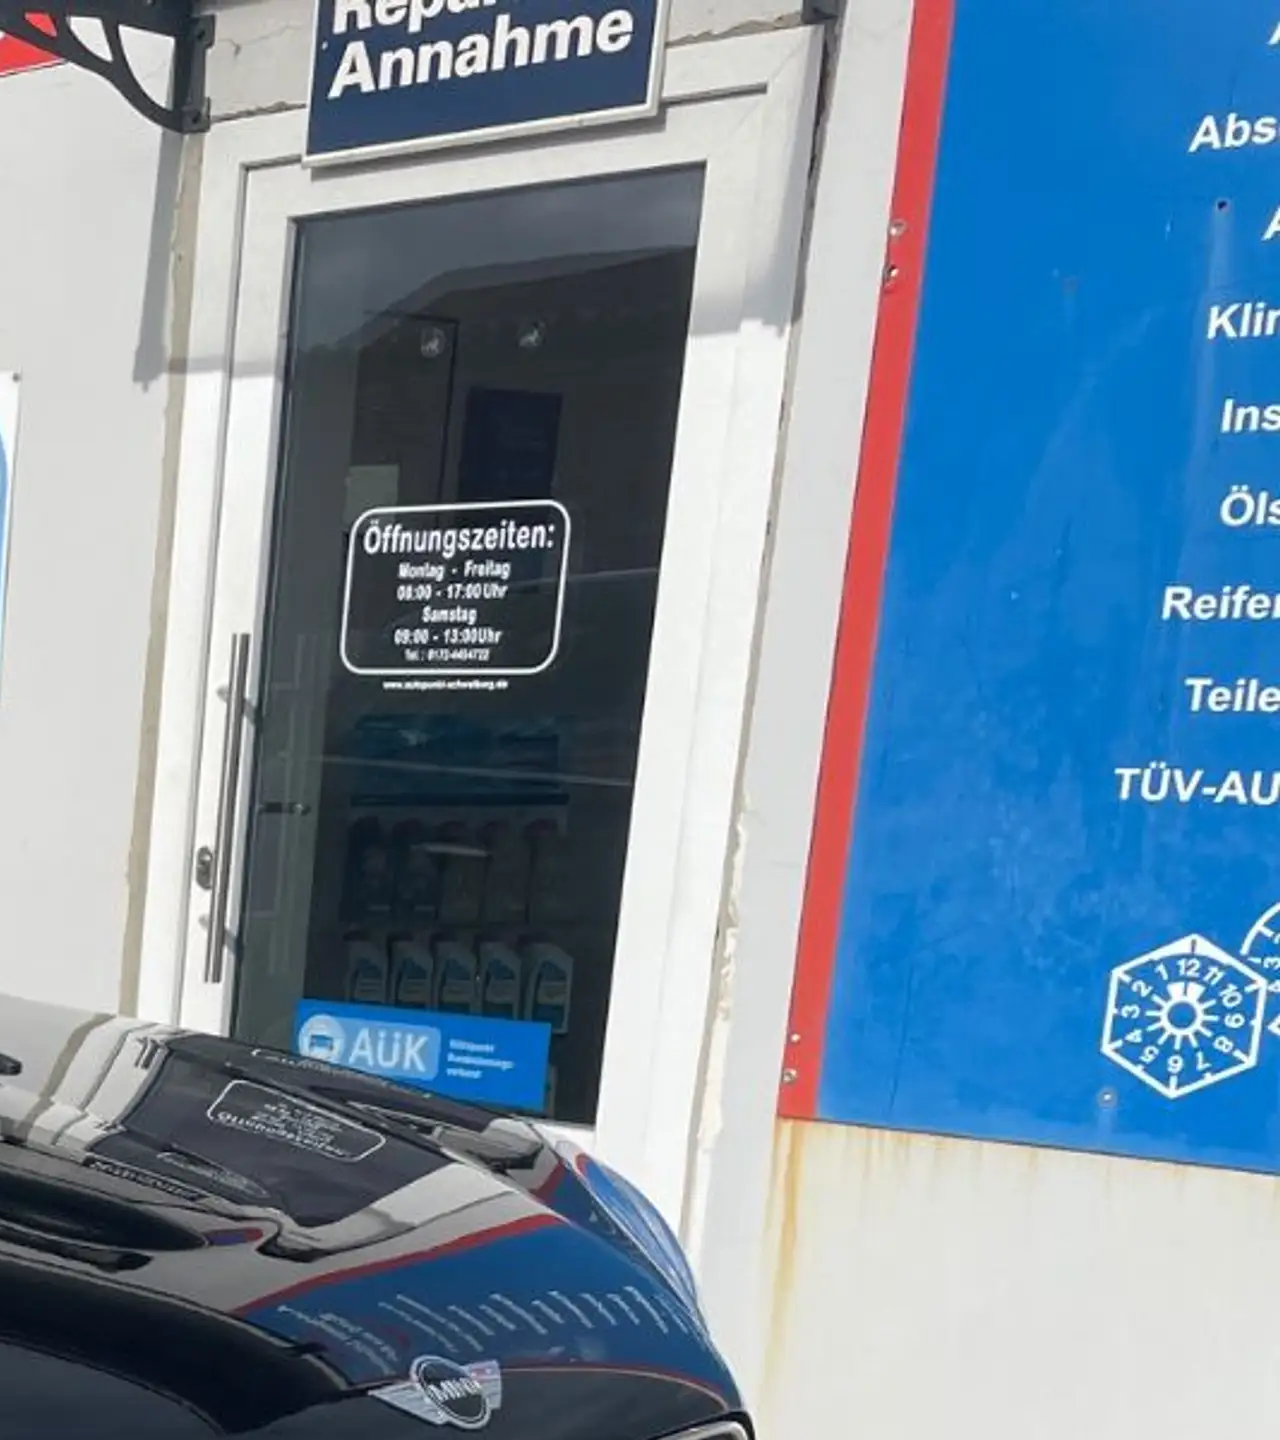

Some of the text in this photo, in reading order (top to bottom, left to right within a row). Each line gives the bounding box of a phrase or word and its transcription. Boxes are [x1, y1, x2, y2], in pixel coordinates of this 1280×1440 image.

[328, 9, 634, 99] Annahme
[362, 519, 556, 559] Öffnungszeiten:
[398, 561, 446, 582] Montag
[463, 559, 511, 581] Freitag
[396, 583, 432, 601] 08:00
[446, 582, 481, 600] 17:00
[483, 582, 509, 599] Uhr
[421, 605, 478, 626] Samstag
[478, 627, 502, 645] Uhr
[1184, 678, 1280, 713] Teile
[1114, 761, 1280, 806] TÜV-AU
[1154, 963, 1169, 981] 1
[1176, 958, 1200, 978] 12
[1203, 966, 1226, 986] 11
[1131, 980, 1153, 997] 2
[1219, 984, 1243, 1008] 10
[1121, 1004, 1141, 1019] 3
[1124, 1029, 1142, 1044] 4
[1213, 1036, 1234, 1053] 8
[348, 1027, 429, 1073] AÜK
[1139, 1045, 1160, 1064] 5
[1167, 1054, 1184, 1074] 6
[1196, 1051, 1212, 1071] 7
